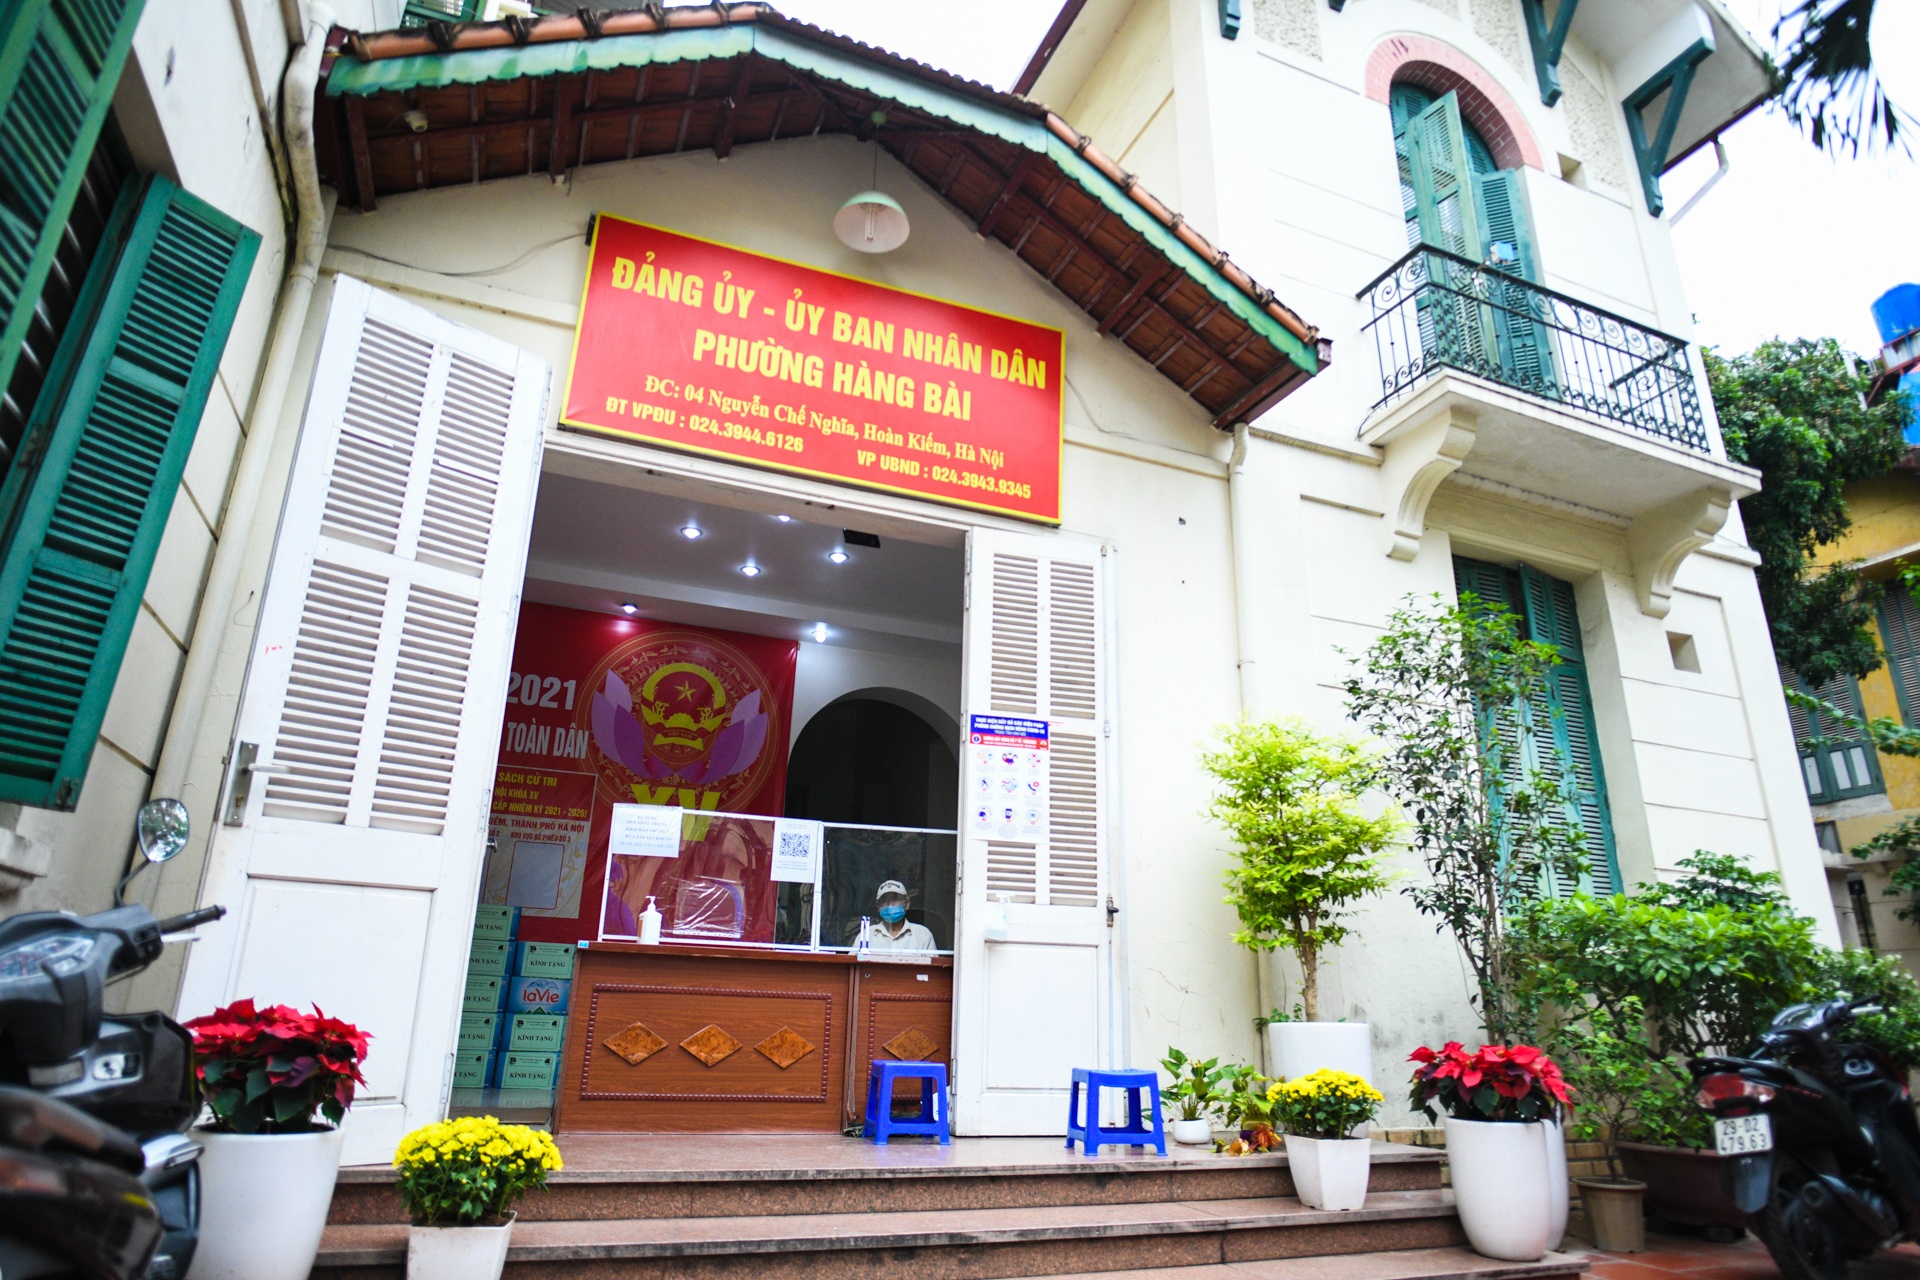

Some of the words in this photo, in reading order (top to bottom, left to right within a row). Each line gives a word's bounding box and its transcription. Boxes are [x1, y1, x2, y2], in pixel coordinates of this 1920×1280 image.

[611, 251, 704, 308] ĐẢNG
[713, 270, 756, 320] ỦY
[785, 288, 825, 336] ỦY
[832, 310, 895, 354] BAN
[903, 327, 982, 375] NHÂN
[991, 348, 1046, 389] DÂN
[692, 328, 825, 389] PHƯỜNG
[832, 360, 915, 409] HÀNG
[924, 380, 972, 421] BÀI
[605, 396, 628, 415] ĐT
[632, 402, 676, 426] VPĐU
[689, 414, 804, 453] 024.3944.6126
[644, 375, 680, 398] ĐC:
[684, 384, 704, 403] 04
[707, 388, 770, 418] Nguyễn
[773, 404, 806, 426] Chế
[809, 411, 859, 440] Nghĩa,
[862, 422, 904, 447] Hoàn
[907, 432, 951, 460] Kiếm,
[954, 442, 976, 462] Hà
[979, 447, 1004, 470] Nội
[857, 449, 876, 467] VP
[880, 453, 920, 477] UBND
[931, 465, 1031, 499] 024.3943.9345
[507, 671, 577, 711] 2021
[506, 717, 551, 756] TOÀN
[552, 722, 590, 760] DÂN
[498, 771, 524, 784] SÁCH
[526, 771, 541, 785] CỨ
[543, 776, 558, 787] TRI
[529, 790, 539, 800] XV
[544, 806, 561, 816] 2021
[567, 807, 588, 818] 2026!
[510, 818, 538, 829] THÀNH
[540, 819, 556, 831] PHỐ
[557, 821, 569, 832] HÀ
[570, 823, 585, 835] NỘI
[485, 924, 504, 932] TẶNG
[482, 958, 500, 966] TẶNG
[548, 961, 566, 969] TẶNG
[473, 996, 491, 1004] TẶNG
[522, 988, 560, 1003] laVie
[467, 1033, 486, 1042] TẶNG
[535, 1035, 554, 1043] TẶNG
[459, 1071, 478, 1079] TẶNG
[509, 1071, 527, 1079] KÍNH
[528, 1072, 546, 1080] TẶNG
[1722, 1117, 1760, 1136] 29-D2
[1721, 1133, 1767, 1152] 479.63
